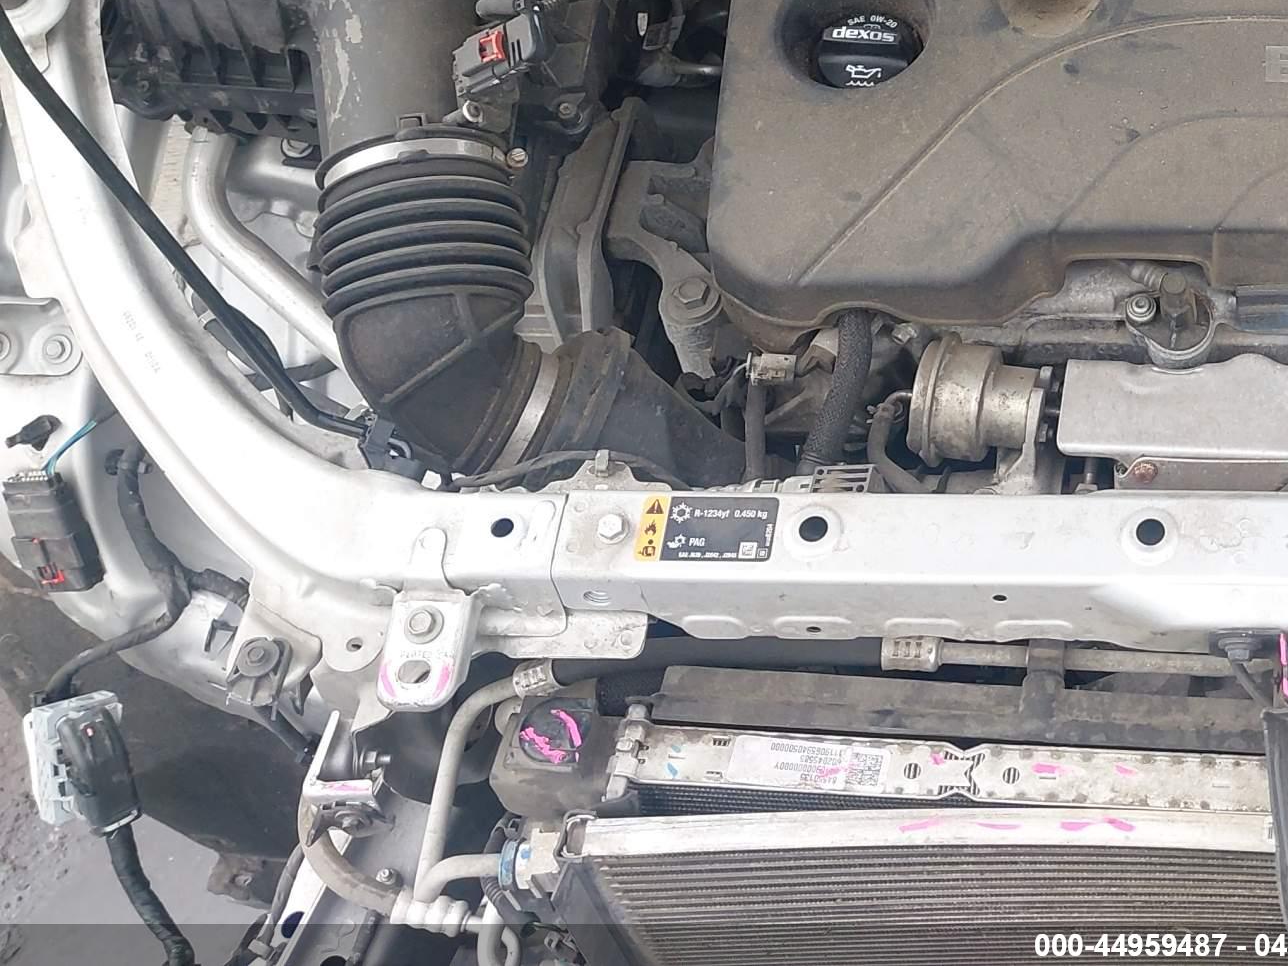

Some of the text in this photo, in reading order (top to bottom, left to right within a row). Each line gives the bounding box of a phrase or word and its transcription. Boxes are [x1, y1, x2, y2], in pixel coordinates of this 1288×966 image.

[847, 15, 898, 29] SAE 0W-20
[832, 25, 898, 42] dexos
[694, 509, 768, 520] R-1234yf 0.450 kg
[689, 537, 706, 547] PAG
